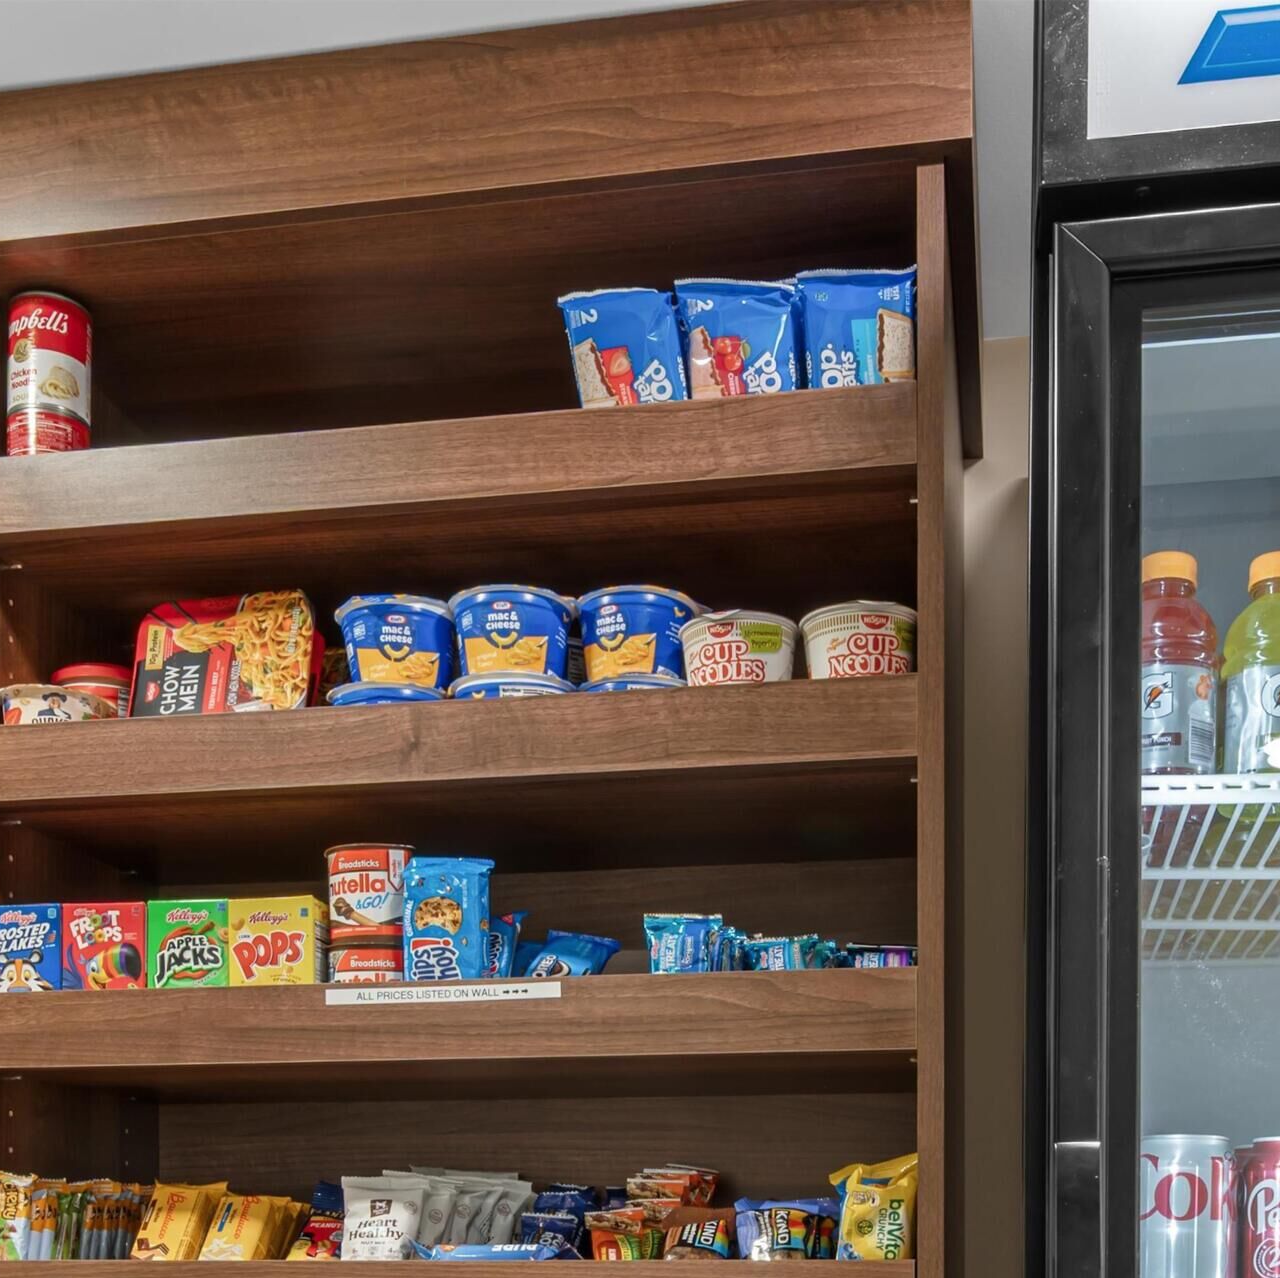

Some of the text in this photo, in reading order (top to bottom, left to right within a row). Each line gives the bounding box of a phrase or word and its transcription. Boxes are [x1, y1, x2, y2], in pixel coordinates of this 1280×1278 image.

[698, 298, 714, 312] 2
[488, 611, 518, 622] mac &
[597, 614, 624, 627] mac &
[382, 626, 410, 636] mac &
[700, 642, 748, 663] CUP
[848, 634, 900, 656] CUP
[690, 659, 764, 686] NOODLES
[830, 655, 909, 676] NOODLES
[160, 666, 181, 715] CHOW
[178, 664, 201, 712] MEIN
[338, 858, 380, 869] Breadsticks
[329, 873, 386, 897] nutella
[70, 909, 120, 937] FROOT
[166, 908, 208, 925] Kellogg's
[249, 910, 290, 926] Kellogg's
[78, 926, 124, 949] LOOPS
[167, 935, 208, 950] APPLE
[153, 945, 222, 986] JACKS
[232, 931, 306, 980] POPS
[350, 958, 396, 968] Breadsticks
[356, 988, 499, 1001] ALL PRICES LISTED ON WALL
[2, 1181, 18, 1220] Chewy
[309, 1222, 342, 1230] PEANUT
[358, 1217, 398, 1229] Heart
[701, 1219, 718, 1246] KIND
[776, 1210, 790, 1245] KIND
[875, 1207, 888, 1252] CRUNCHY
[888, 1199, 905, 1260] belVita
